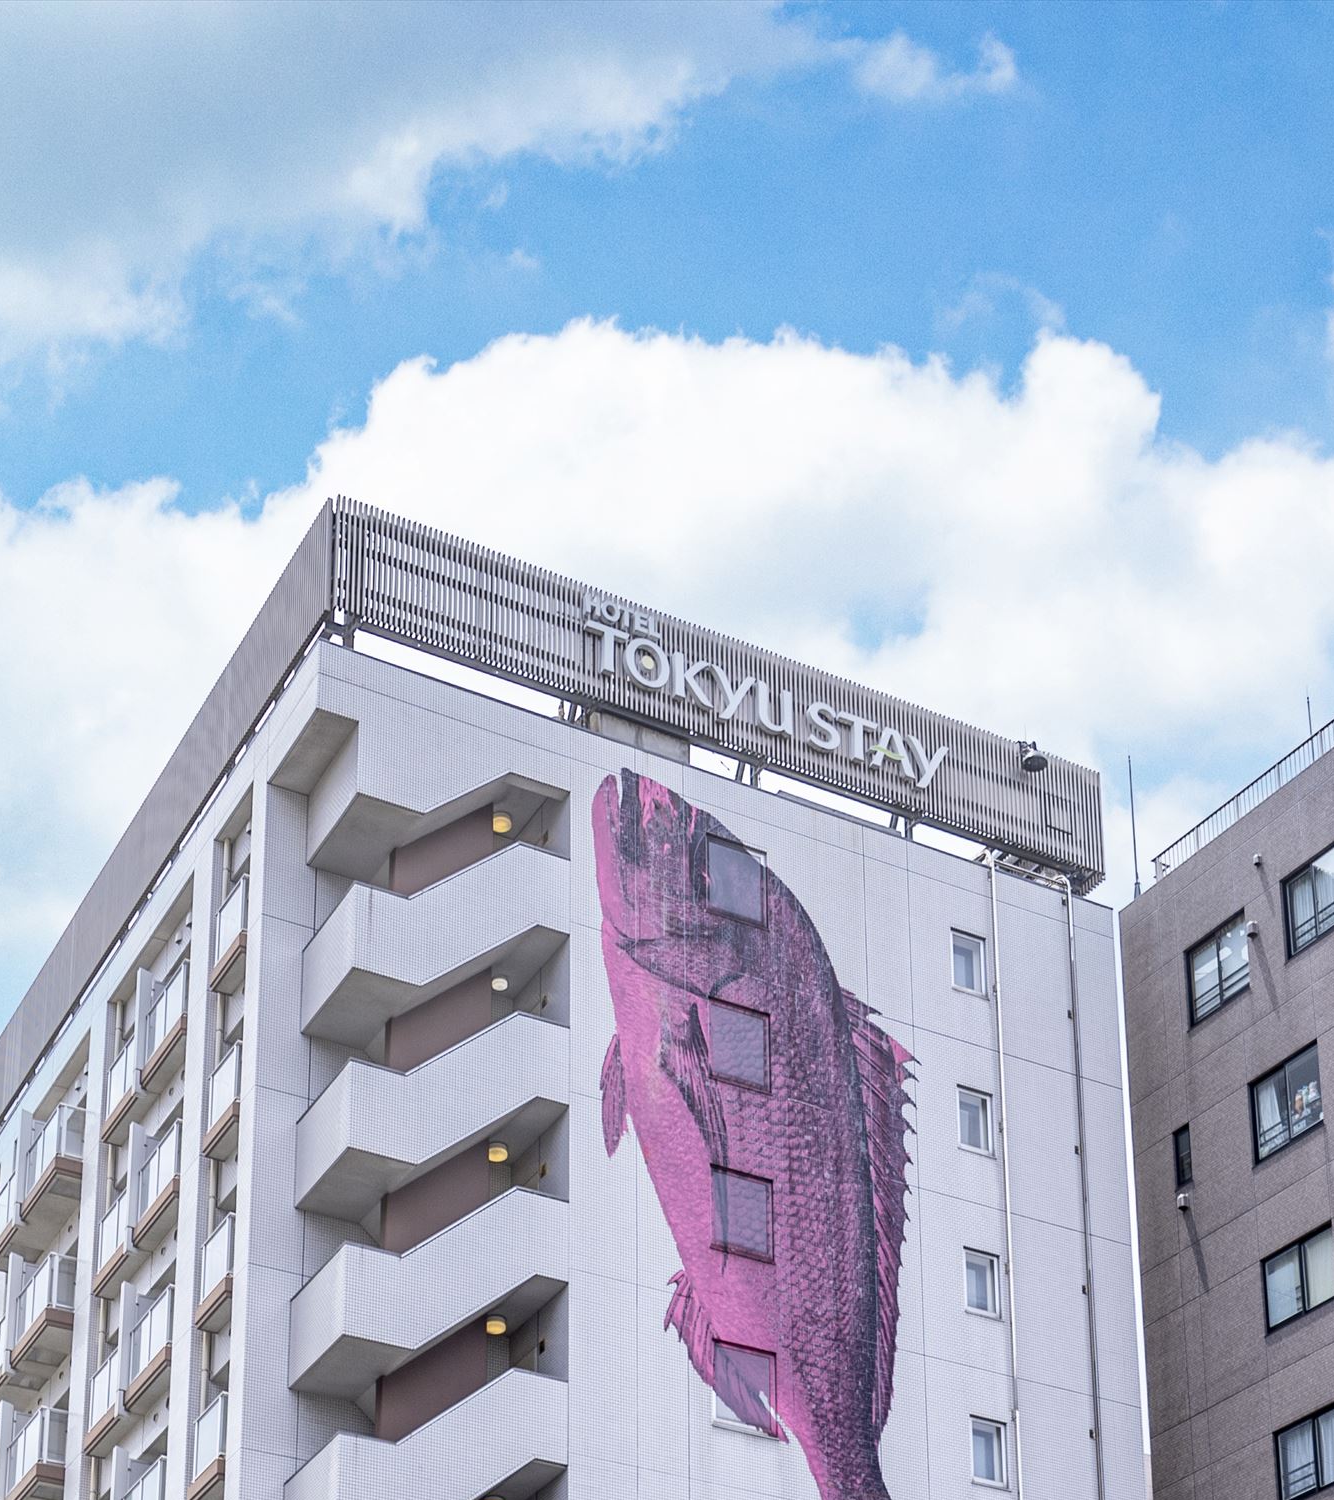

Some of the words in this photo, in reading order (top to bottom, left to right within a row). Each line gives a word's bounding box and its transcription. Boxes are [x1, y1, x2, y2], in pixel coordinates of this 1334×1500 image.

[584, 597, 659, 640] HOTEL
[585, 619, 793, 739] TOKYU
[805, 700, 948, 790] STAY
